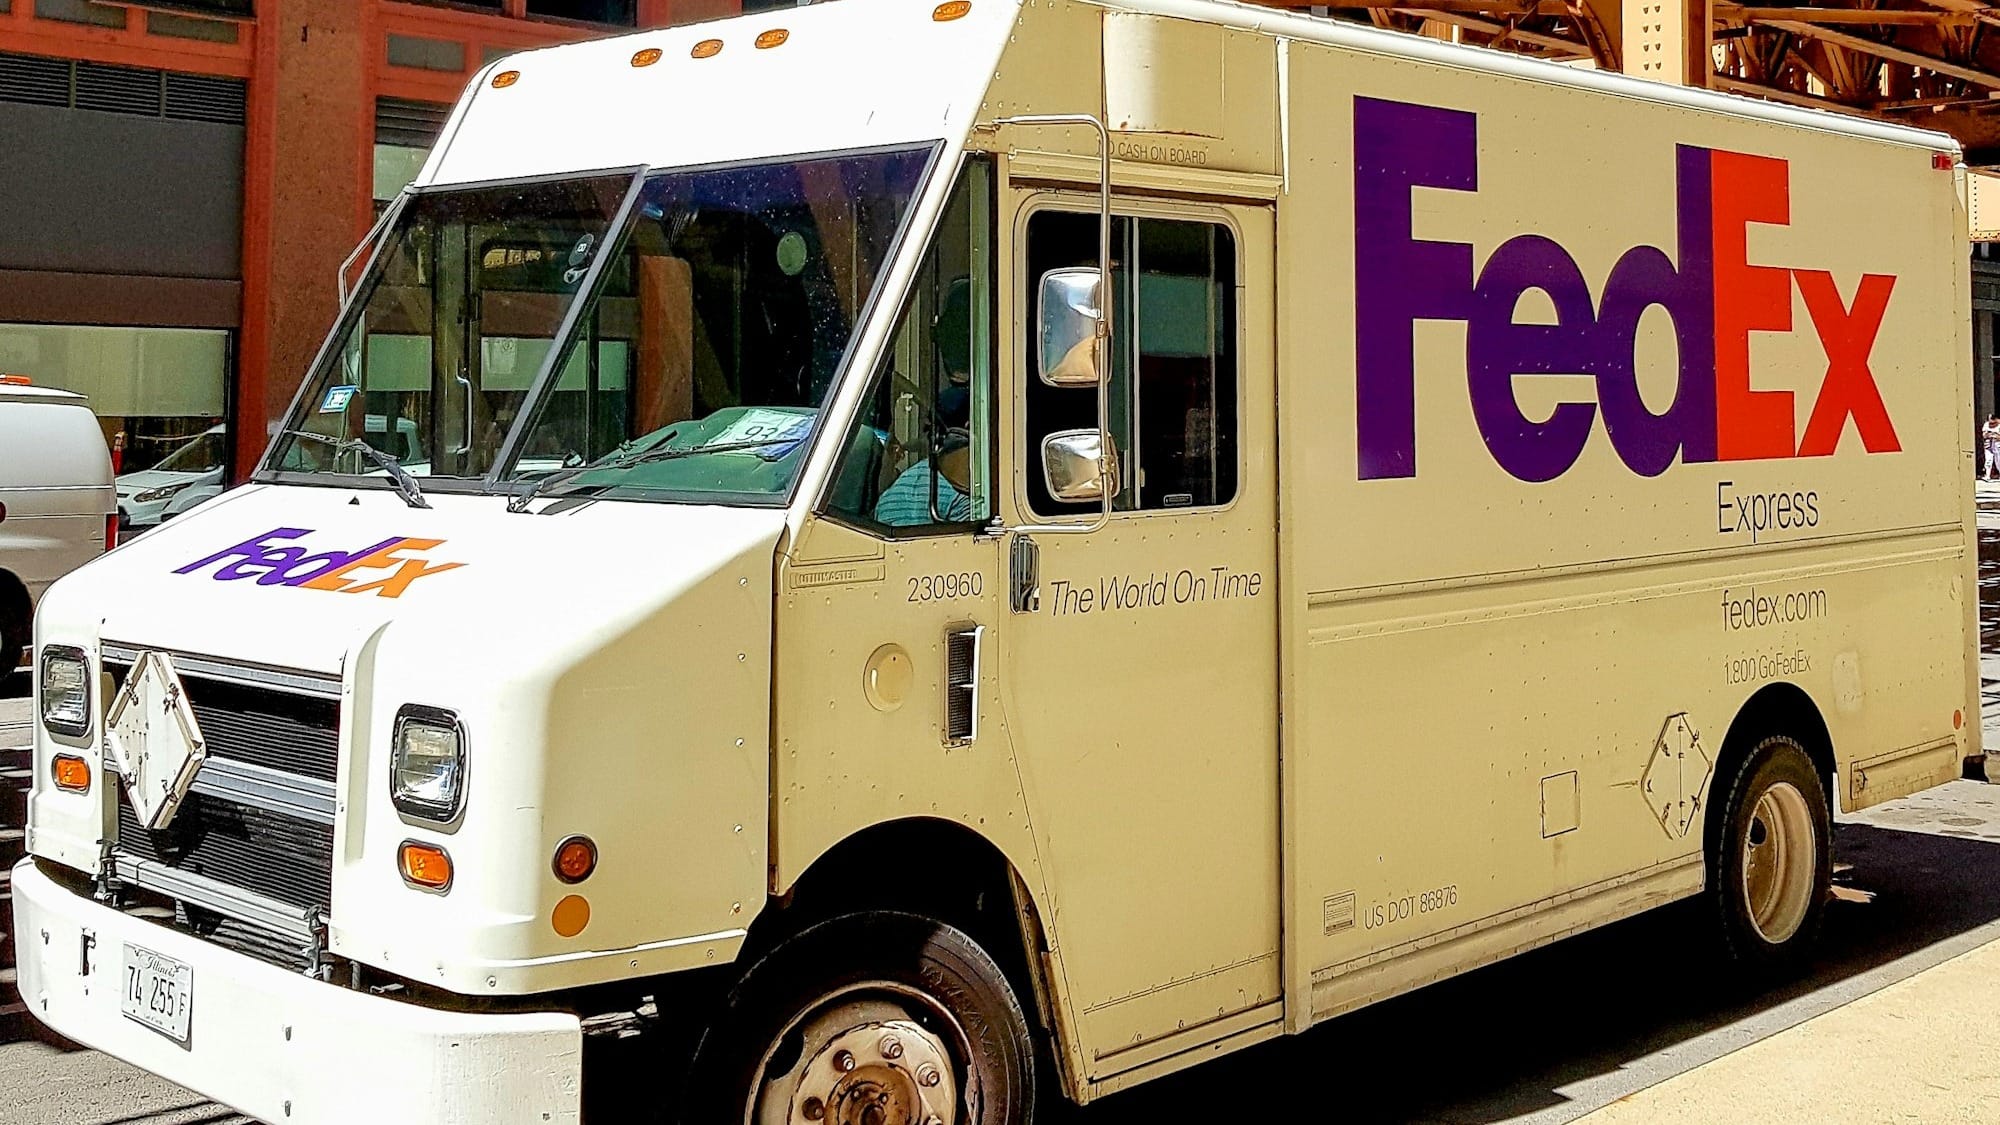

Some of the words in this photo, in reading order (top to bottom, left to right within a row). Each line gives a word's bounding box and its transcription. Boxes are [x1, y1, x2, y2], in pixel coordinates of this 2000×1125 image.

[1098, 141, 1115, 155] O
[1118, 142, 1148, 160] CASH
[1150, 146, 1167, 161] ON
[1170, 148, 1207, 165] BOARD
[1353, 95, 1903, 483] FedEx
[1718, 481, 1820, 544] Express
[170, 527, 470, 598] FedEx
[908, 571, 983, 602] 230960
[1050, 580, 1094, 617] The
[1099, 572, 1169, 612] World
[1174, 569, 1206, 604] On
[1211, 566, 1262, 600] Time
[1721, 587, 1827, 632] fedex.com
[1724, 657, 1756, 685] 1.800
[1758, 650, 1812, 679] GoFedEx
[1364, 905, 1384, 930] US
[1388, 895, 1416, 923] DOT
[1419, 884, 1457, 914] 86876
[128, 965, 142, 1006] 74
[150, 976, 175, 1017] 255
[179, 992, 187, 1017] F
